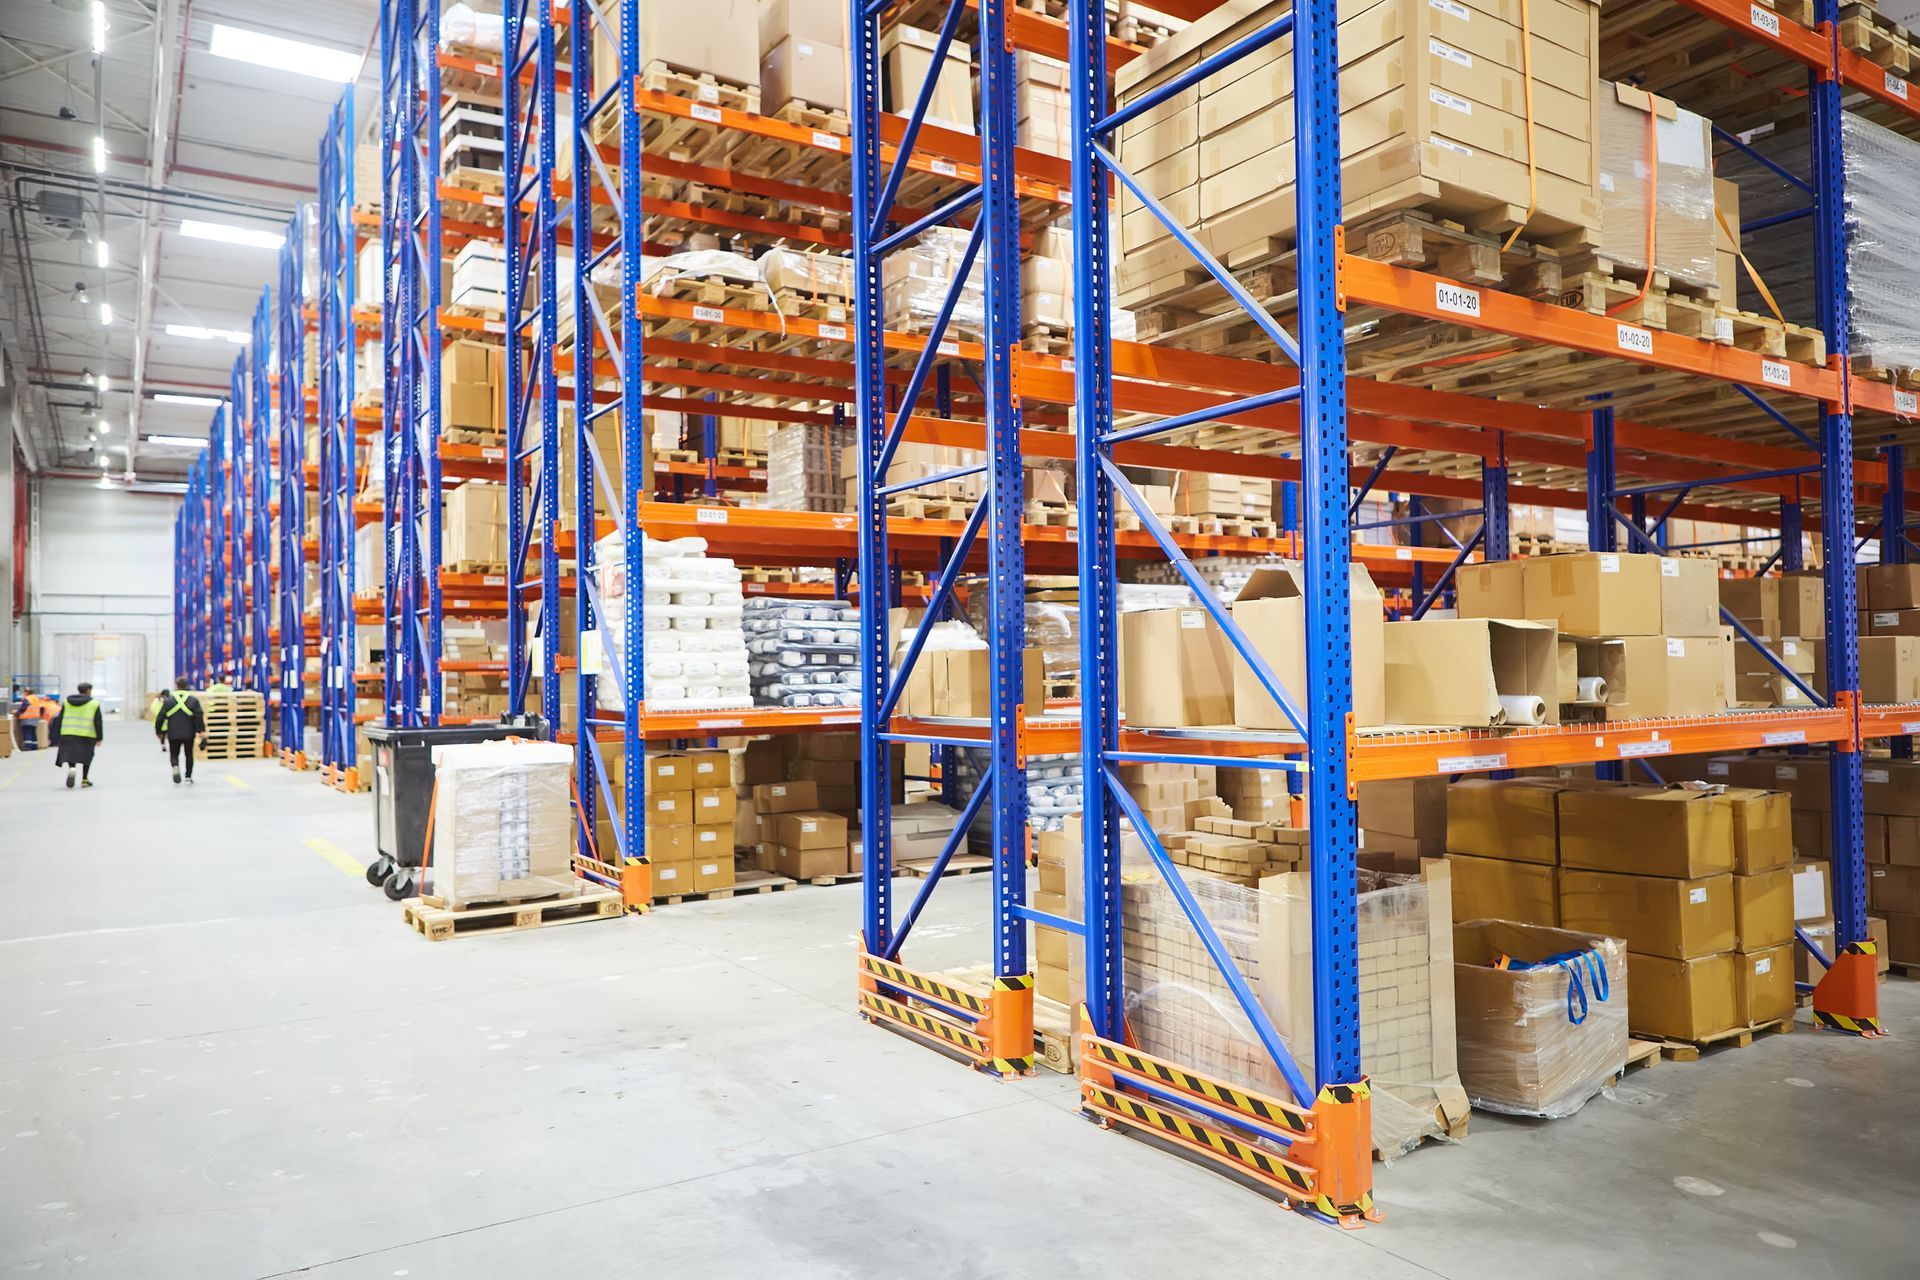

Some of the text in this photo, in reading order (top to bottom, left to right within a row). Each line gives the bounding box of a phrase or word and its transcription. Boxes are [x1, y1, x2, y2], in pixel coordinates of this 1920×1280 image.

[1438, 289, 1477, 310] 01-01-20
[1560, 293, 1577, 307] EUR
[1620, 330, 1650, 348] 01-02-20
[1764, 365, 1788, 381] 01-03-20
[699, 511, 726, 520] 03-01-20
